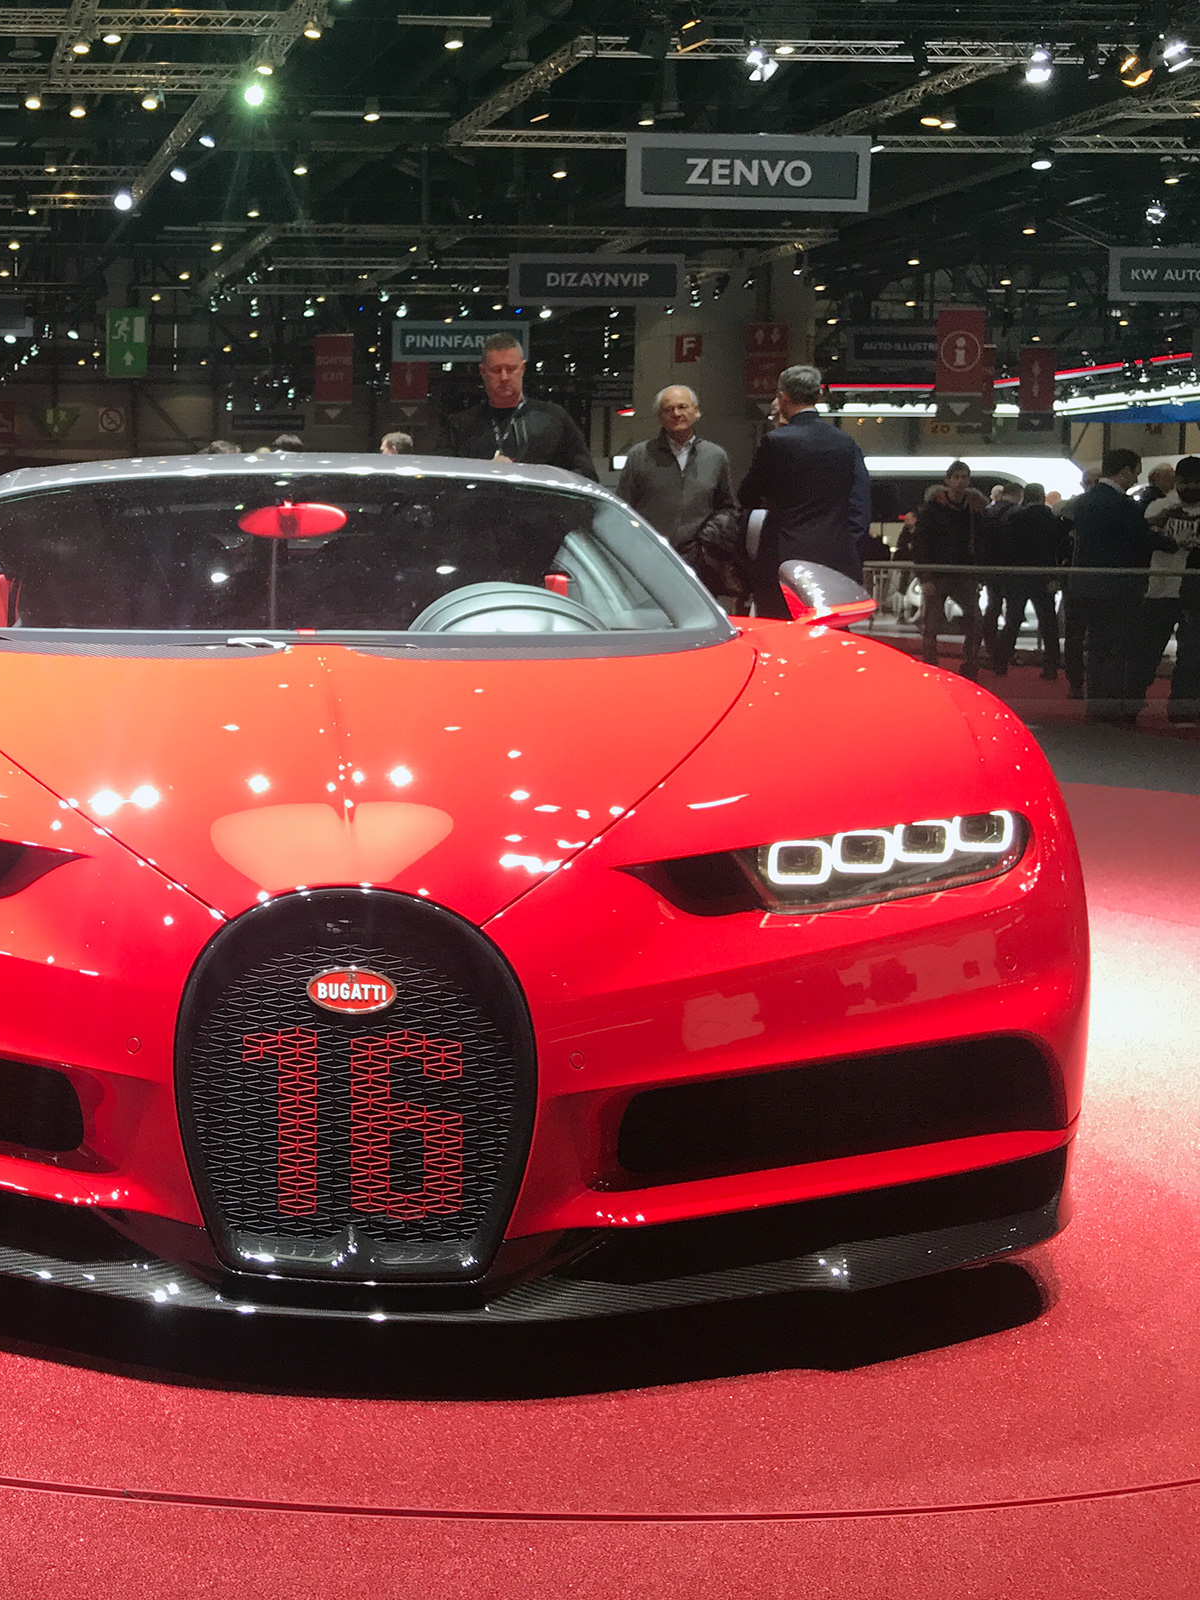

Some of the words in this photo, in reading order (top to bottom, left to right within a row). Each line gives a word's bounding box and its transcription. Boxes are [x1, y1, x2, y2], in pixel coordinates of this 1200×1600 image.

[685, 157, 813, 188] ZENVO
[546, 271, 650, 288] DIZAYNVIP
[1131, 268, 1158, 281] KW
[683, 337, 696, 356] F
[317, 982, 386, 1001] BUGATTI
[243, 1026, 462, 1221] 16
